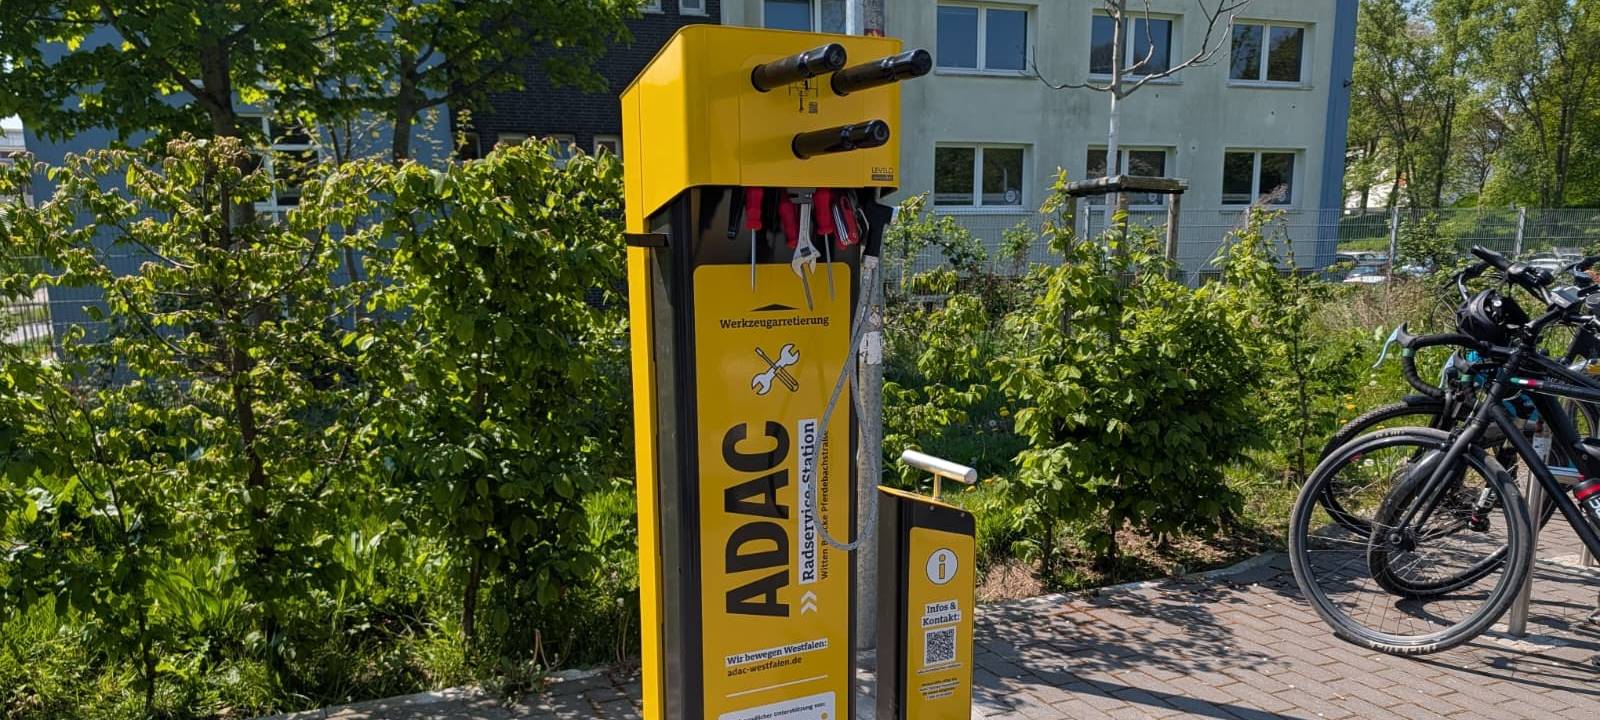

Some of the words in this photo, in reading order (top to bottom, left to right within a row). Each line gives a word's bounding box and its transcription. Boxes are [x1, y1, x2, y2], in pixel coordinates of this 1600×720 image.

[720, 316, 829, 329] Werkzeugarretierung
[722, 421, 790, 617] ADAC
[821, 548, 829, 580] Witten
[927, 603, 949, 614] Infos
[950, 601, 956, 610] &
[923, 613, 960, 626] Kontakt:
[727, 655, 744, 665] Wir
[745, 648, 782, 659] bewegen
[784, 640, 827, 654] Westfalen:
[727, 656, 803, 676] adac-westfalen.de
